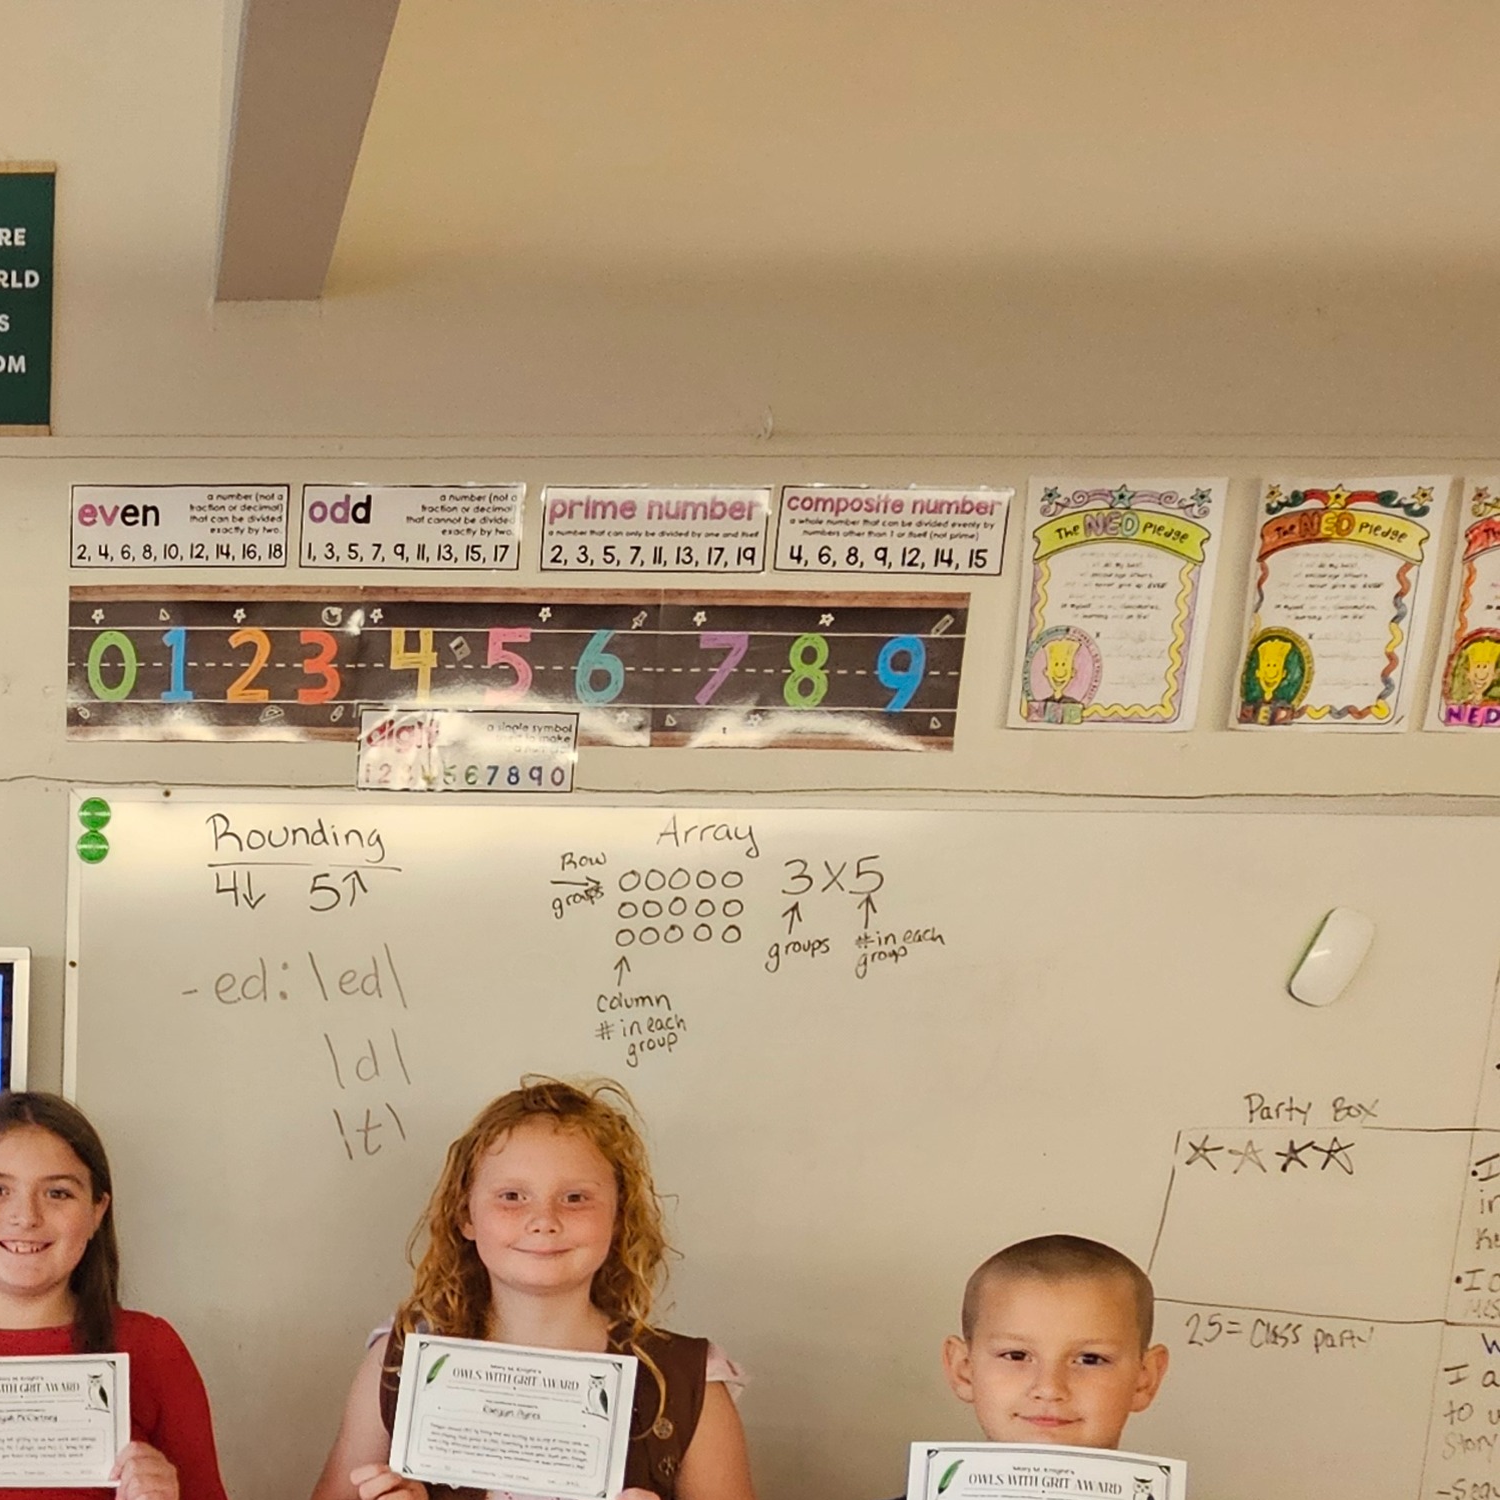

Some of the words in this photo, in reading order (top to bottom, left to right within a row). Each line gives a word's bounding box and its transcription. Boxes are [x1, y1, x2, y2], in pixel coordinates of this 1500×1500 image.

[216, 492, 252, 501] number
[308, 495, 372, 524] odd
[787, 494, 905, 516] composite
[911, 497, 1001, 516] number
[77, 498, 160, 528] even
[190, 515, 208, 523] that
[232, 515, 244, 523] be
[247, 515, 283, 523] divided
[549, 496, 637, 525] prime
[647, 497, 760, 521] number
[1299, 511, 1356, 537] NED
[210, 526, 245, 535] exactly
[247, 526, 259, 535] by
[1055, 523, 1080, 540] The
[1083, 511, 1139, 537] NED
[76, 545, 92, 562] 2,
[98, 545, 114, 562] 4,
[120, 545, 136, 562] 6,
[142, 545, 157, 562] 8,
[163, 544, 184, 562] 10,
[190, 543, 209, 561] 12,
[216, 543, 235, 561] 14,
[242, 543, 261, 561] 16,
[268, 543, 283, 560] 18
[550, 545, 568, 566] 2,
[576, 545, 595, 566] 3,
[602, 545, 621, 567] 5,
[629, 545, 645, 567] 7,
[675, 545, 699, 567] 13,
[707, 547, 728, 568] 17,
[737, 546, 756, 566] 19
[789, 545, 809, 567] 4,
[818, 545, 837, 567] 6,
[846, 546, 864, 568] 8,
[901, 547, 926, 569] 12,
[934, 548, 960, 570] 14,
[968, 549, 988, 569] 15
[88, 631, 137, 702] 0
[161, 627, 193, 703] 1
[226, 628, 271, 703] 2
[298, 630, 341, 704] 3
[390, 628, 438, 702] 4
[484, 628, 534, 704] 5
[575, 629, 625, 708] 6
[695, 633, 749, 706] 7
[783, 633, 829, 710] 8
[877, 635, 927, 713] 9
[206, 813, 385, 863] Rounding
[656, 814, 760, 858] Array
[215, 872, 240, 907] 4
[309, 873, 341, 912] 5
[902, 927, 946, 946] each
[765, 936, 831, 972] groups
[855, 944, 909, 979] group
[646, 1014, 687, 1033] each
[626, 1032, 679, 1068] group
[1244, 1092, 1313, 1127] Party
[1332, 1096, 1380, 1121] Box
[453, 1367, 482, 1380] OWLS
[485, 1371, 512, 1384] WITH
[513, 1375, 538, 1387] GRIT
[968, 1473, 1005, 1486] OWLS
[1008, 1475, 1039, 1488] WITH
[1042, 1476, 1073, 1489] GRIT
[1076, 1478, 1123, 1495] AWARD
